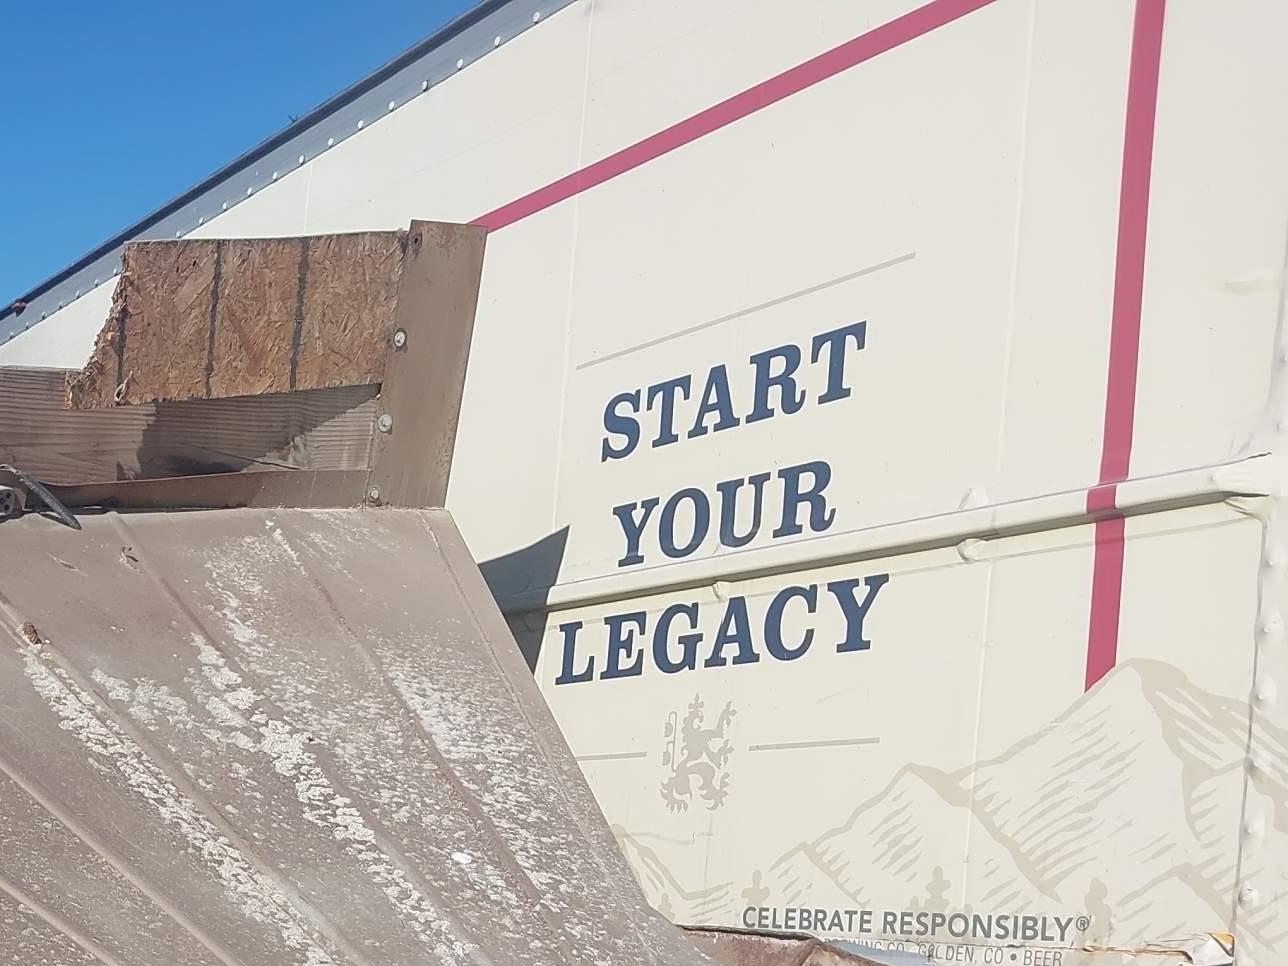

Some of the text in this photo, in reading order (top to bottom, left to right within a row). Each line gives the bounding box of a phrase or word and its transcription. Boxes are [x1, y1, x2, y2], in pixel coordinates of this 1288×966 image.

[602, 320, 867, 462] START
[613, 460, 836, 567] YOUR
[555, 574, 890, 685] LEGACY
[742, 906, 872, 933] CELEBRATE
[984, 947, 1004, 964] CO
